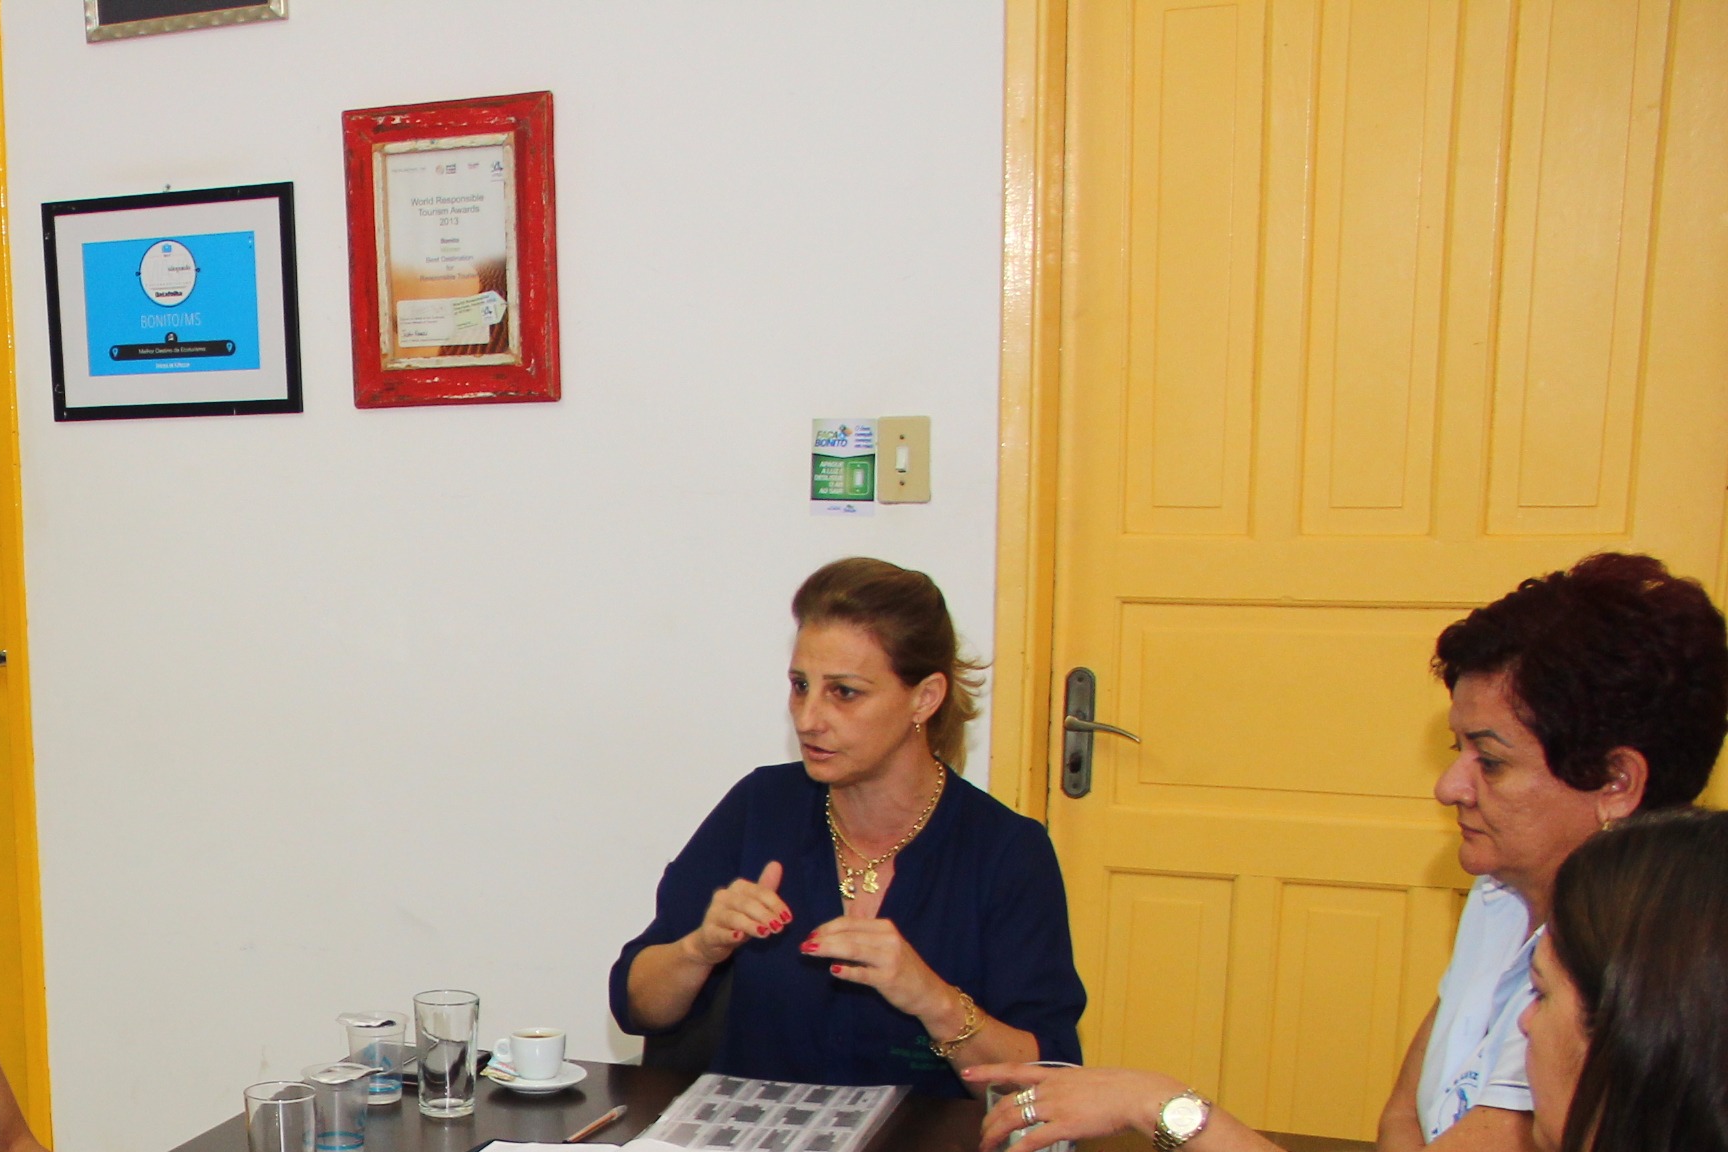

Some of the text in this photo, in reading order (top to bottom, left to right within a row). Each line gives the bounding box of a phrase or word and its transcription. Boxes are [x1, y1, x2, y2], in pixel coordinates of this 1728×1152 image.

[411, 194, 484, 206] World Responsible
[419, 205, 480, 216] Tourism Awards
[440, 217, 458, 226] 2013
[141, 313, 201, 328] BONITO/MS
[815, 439, 847, 447] BONITO
